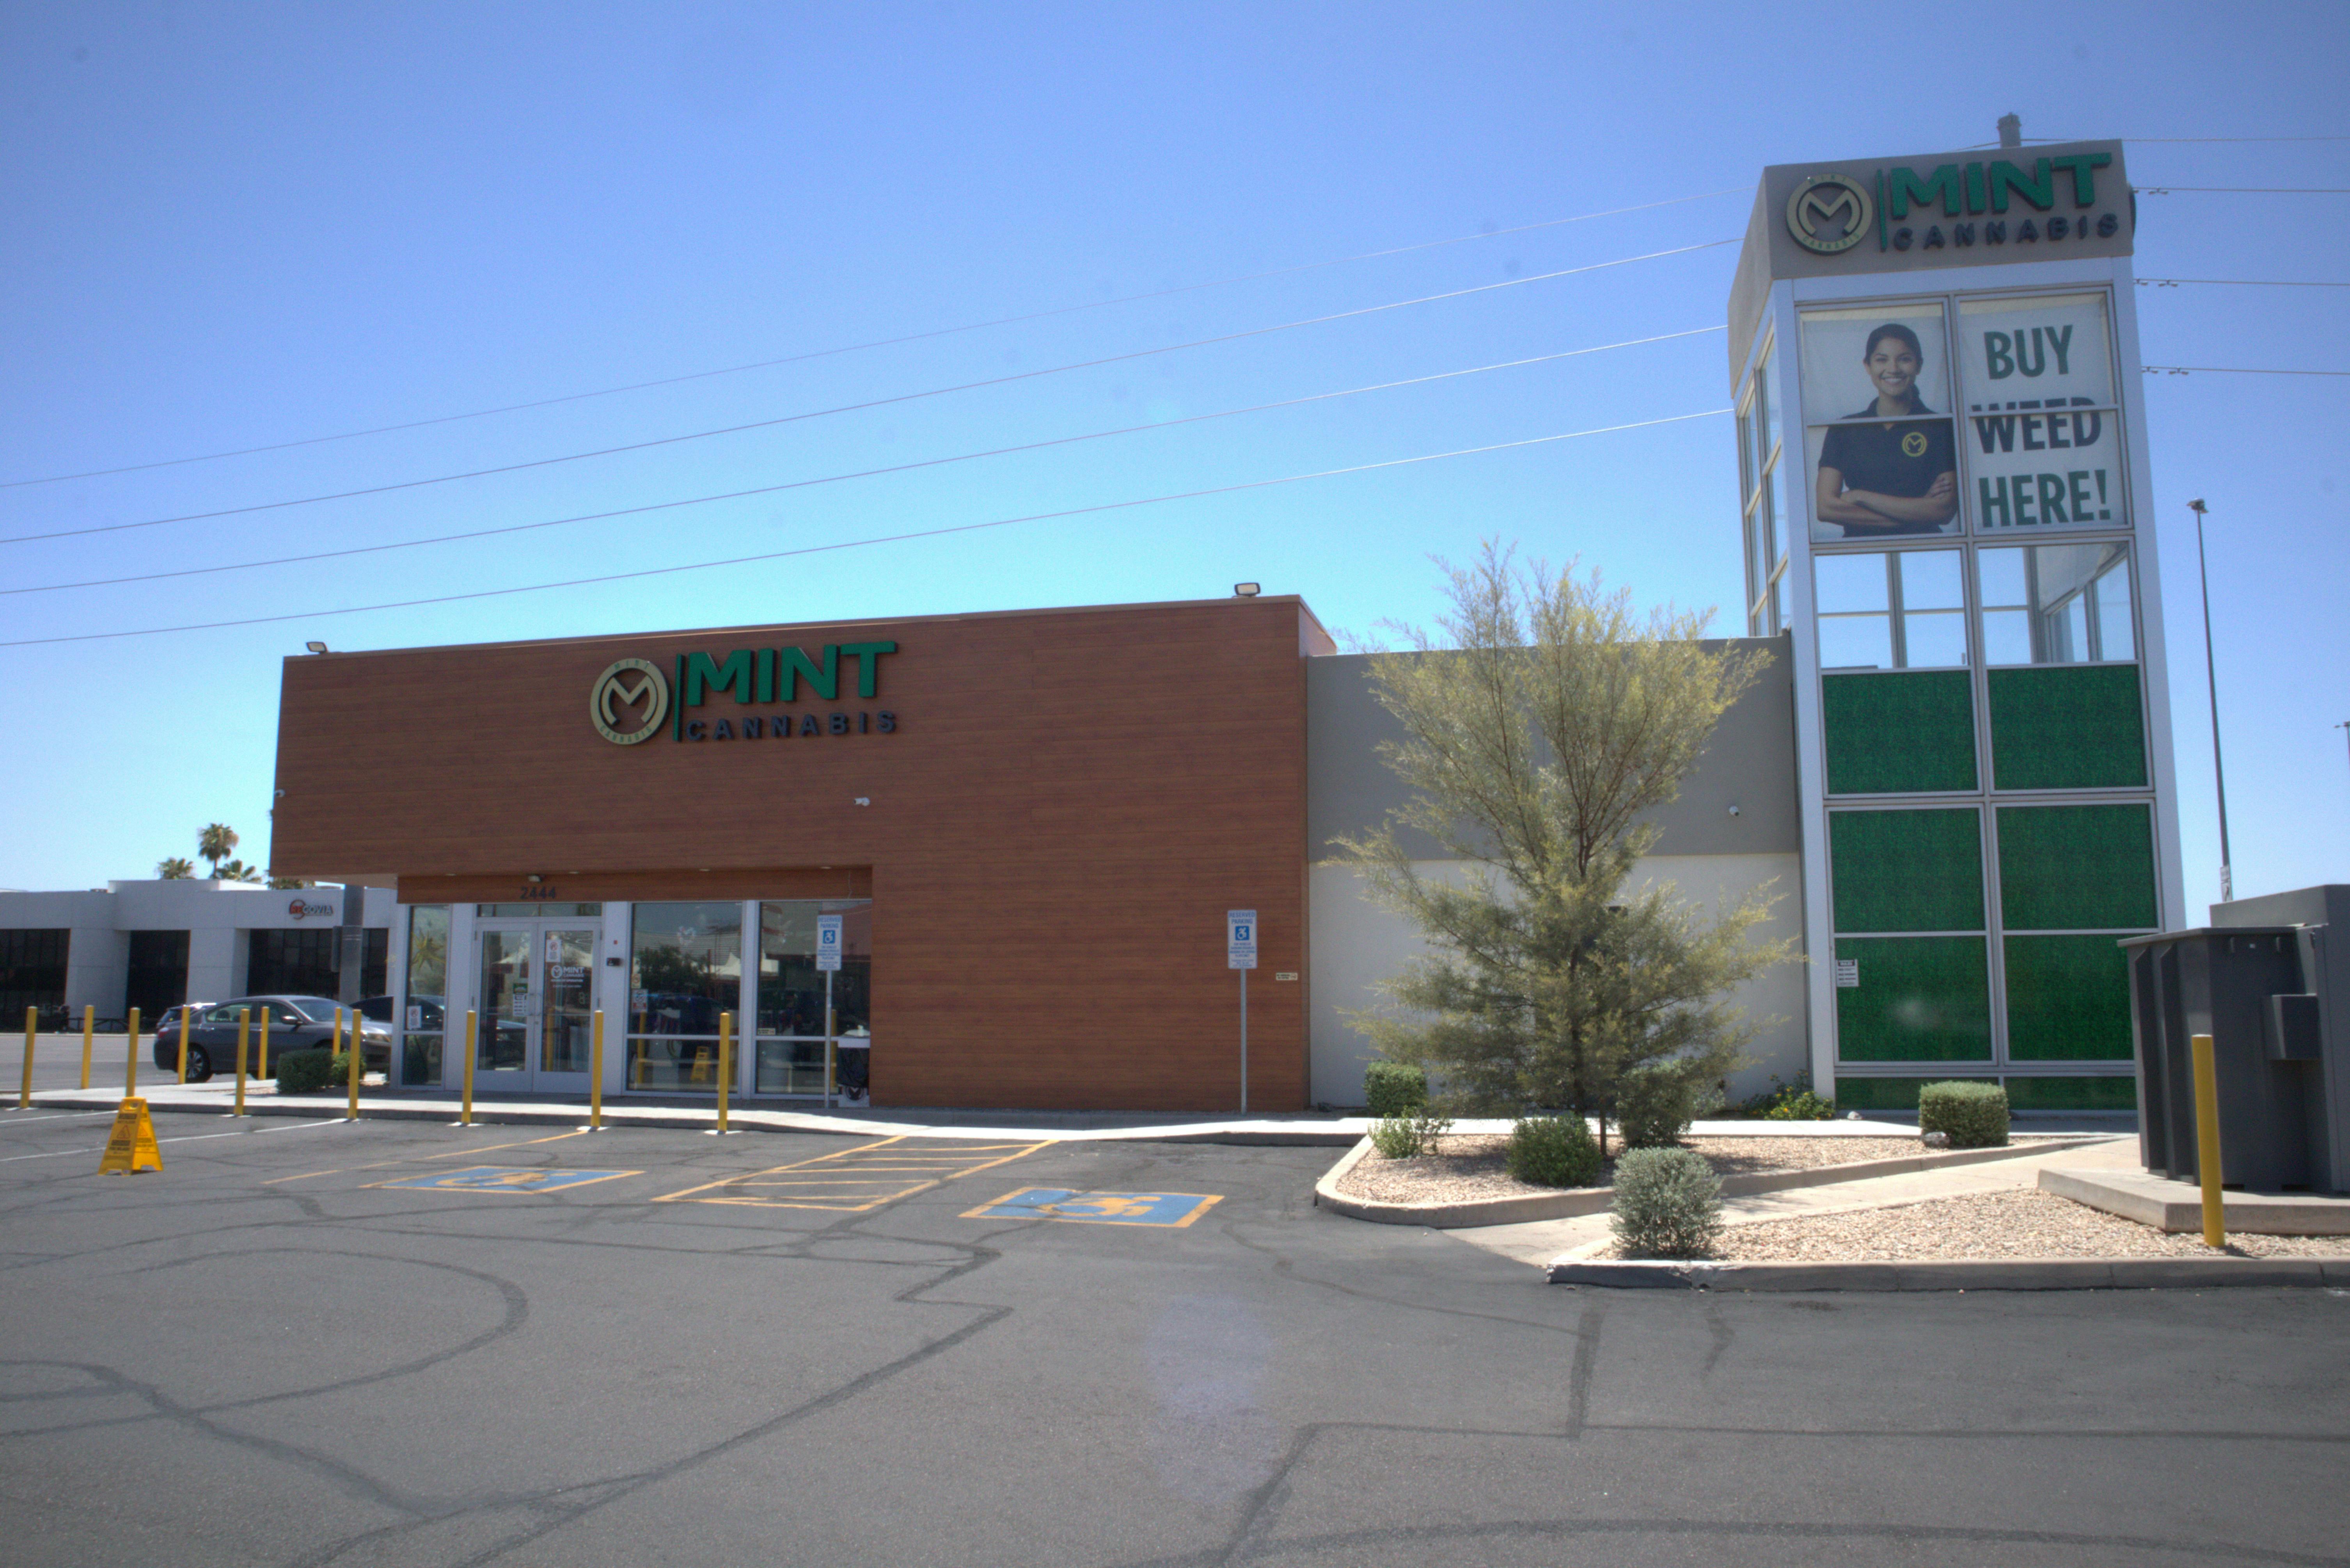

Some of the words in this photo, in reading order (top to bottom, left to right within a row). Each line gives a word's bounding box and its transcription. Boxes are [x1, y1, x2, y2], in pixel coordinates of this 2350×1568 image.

[1889, 153, 2112, 220] MINT
[1894, 213, 2119, 252] CANNABIS
[1983, 324, 2073, 380] BUY
[1971, 397, 2101, 454] WEED
[1978, 469, 2110, 528] HERE!
[687, 641, 898, 706] MINT
[686, 710, 896, 740] CANNABIS
[520, 886, 556, 899] 2444
